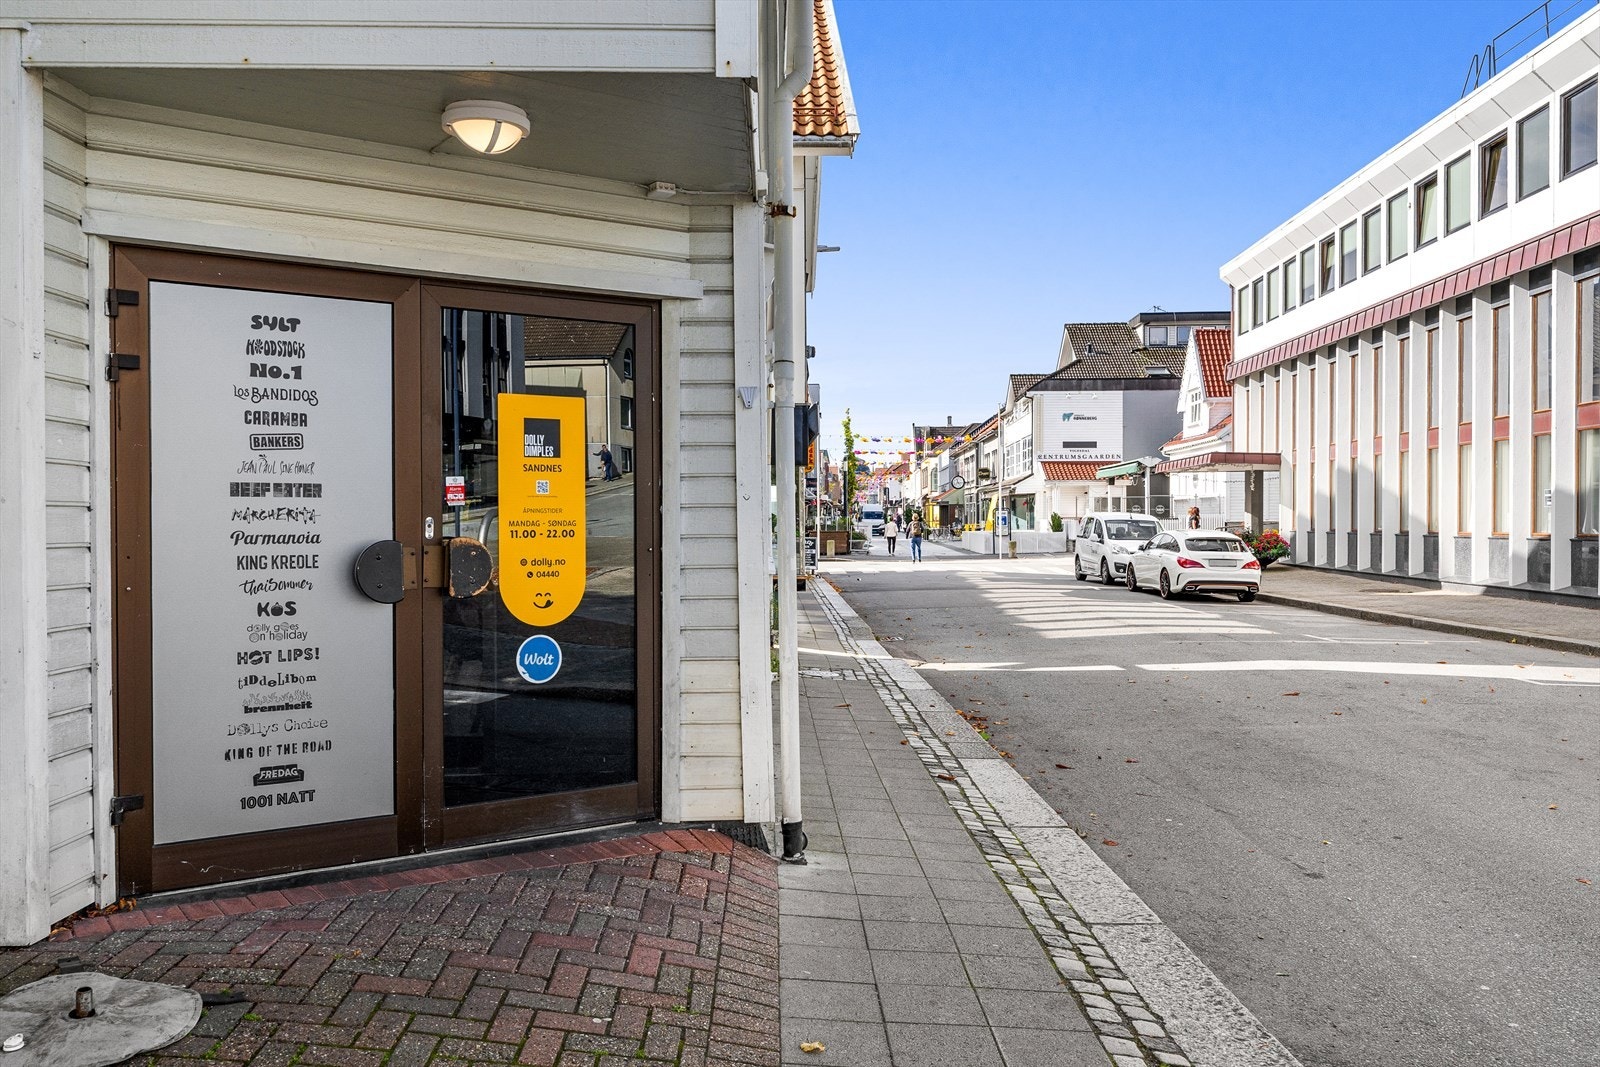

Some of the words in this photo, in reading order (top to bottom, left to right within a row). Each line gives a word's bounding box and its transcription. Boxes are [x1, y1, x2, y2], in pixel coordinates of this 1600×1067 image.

[250, 363, 302, 379] No.1
[251, 388, 318, 406] BANDIDOS
[245, 410, 308, 427] CARAMBA
[253, 436, 300, 448] BANKERS
[524, 434, 544, 446] DOLLY
[524, 446, 554, 457] DIMPLES
[523, 464, 562, 472] SANDNES
[230, 482, 271, 497] BEEF
[273, 483, 322, 498] EATER
[230, 531, 321, 546] Parmanoia
[510, 530, 536, 539] 11.00
[547, 529, 575, 538] 22.00
[237, 556, 267, 570] KING
[271, 555, 319, 569] KREOLE
[531, 557, 566, 567] dolly.no
[536, 570, 560, 578] 04440
[247, 622, 270, 633] dolly
[269, 630, 308, 641] holiday
[237, 650, 272, 665] HOT
[278, 648, 320, 663] LIPS!
[524, 652, 554, 666] Wolt
[244, 701, 313, 714] brennheit
[227, 723, 279, 737] Dollys
[284, 718, 328, 732] Choice
[225, 747, 253, 762] KING
[259, 745, 272, 757] OF
[277, 743, 298, 755] THE
[302, 740, 332, 753] ROAD
[259, 768, 298, 779] FREDAG
[240, 794, 273, 809] 1001
[277, 790, 315, 805] NATT
